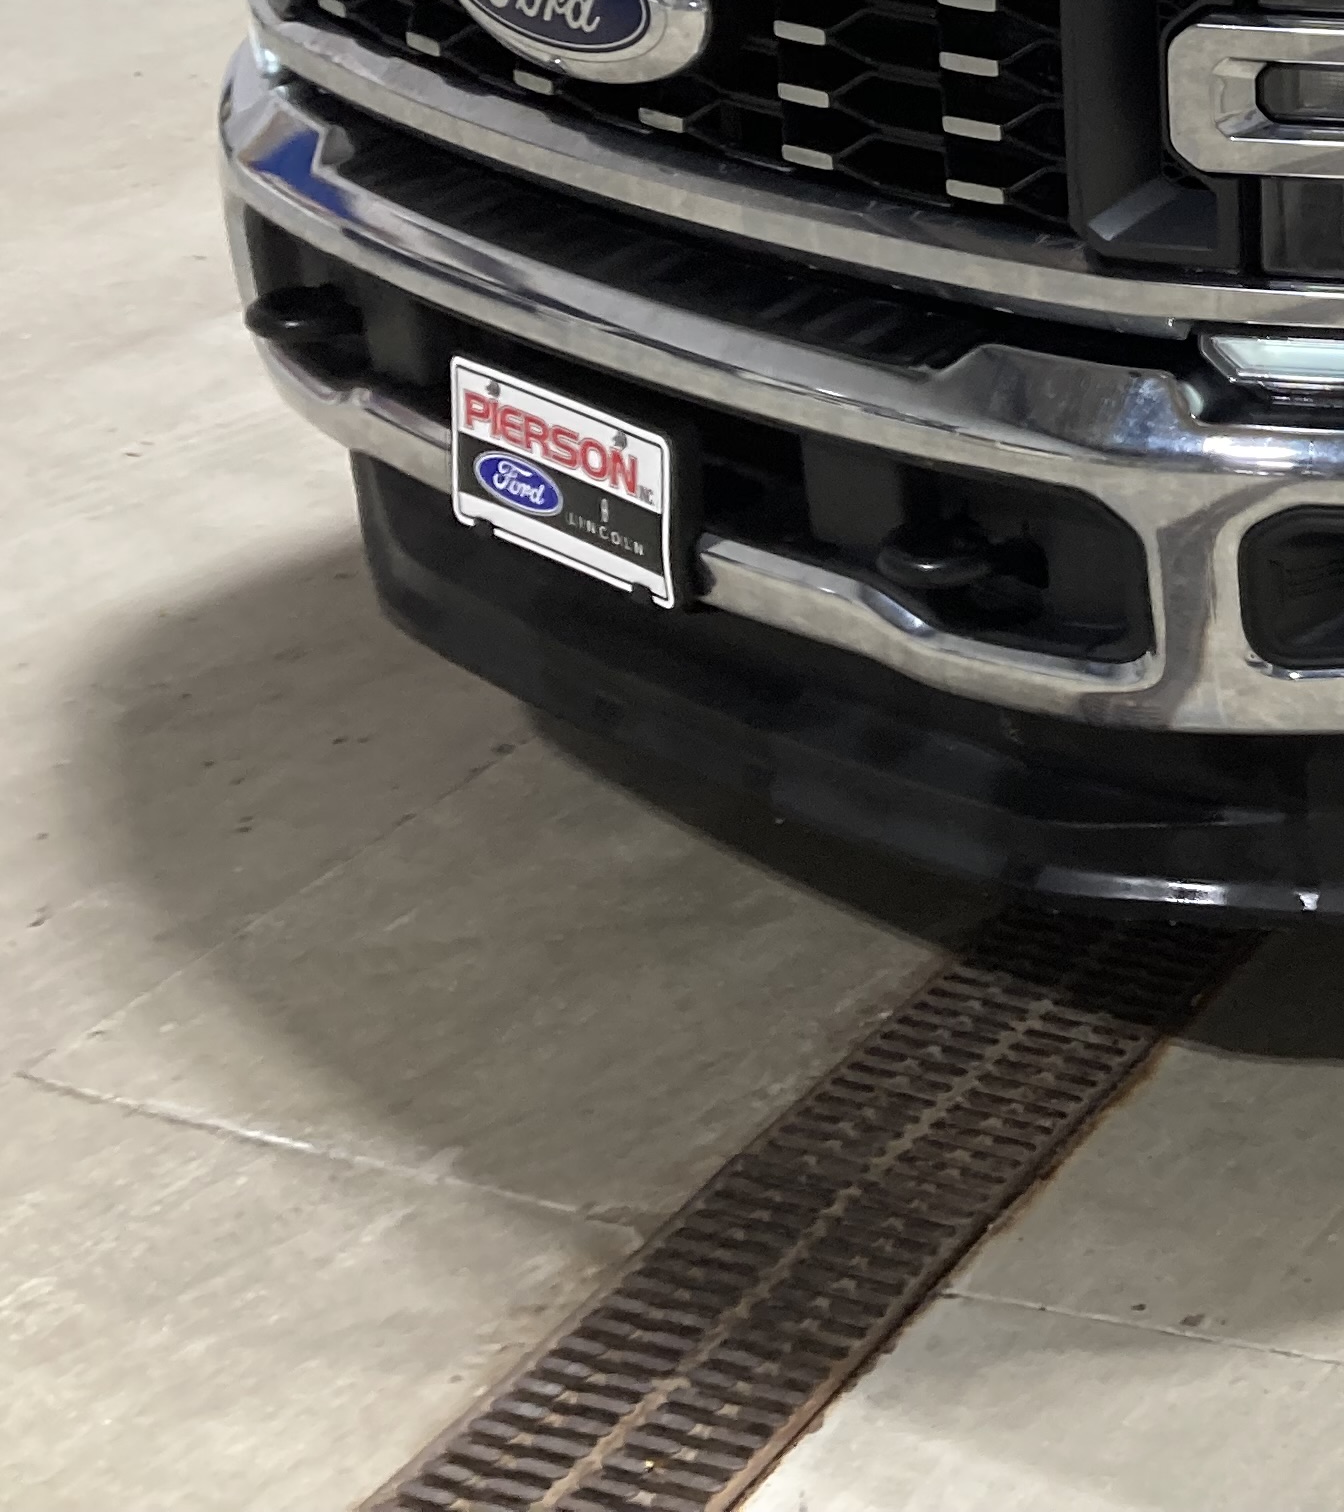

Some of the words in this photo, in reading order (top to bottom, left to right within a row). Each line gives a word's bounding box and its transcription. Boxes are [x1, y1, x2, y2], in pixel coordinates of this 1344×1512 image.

[463, 388, 639, 498] PIERSON
[492, 460, 545, 506] Ford
[565, 511, 645, 557] LINCOLN
